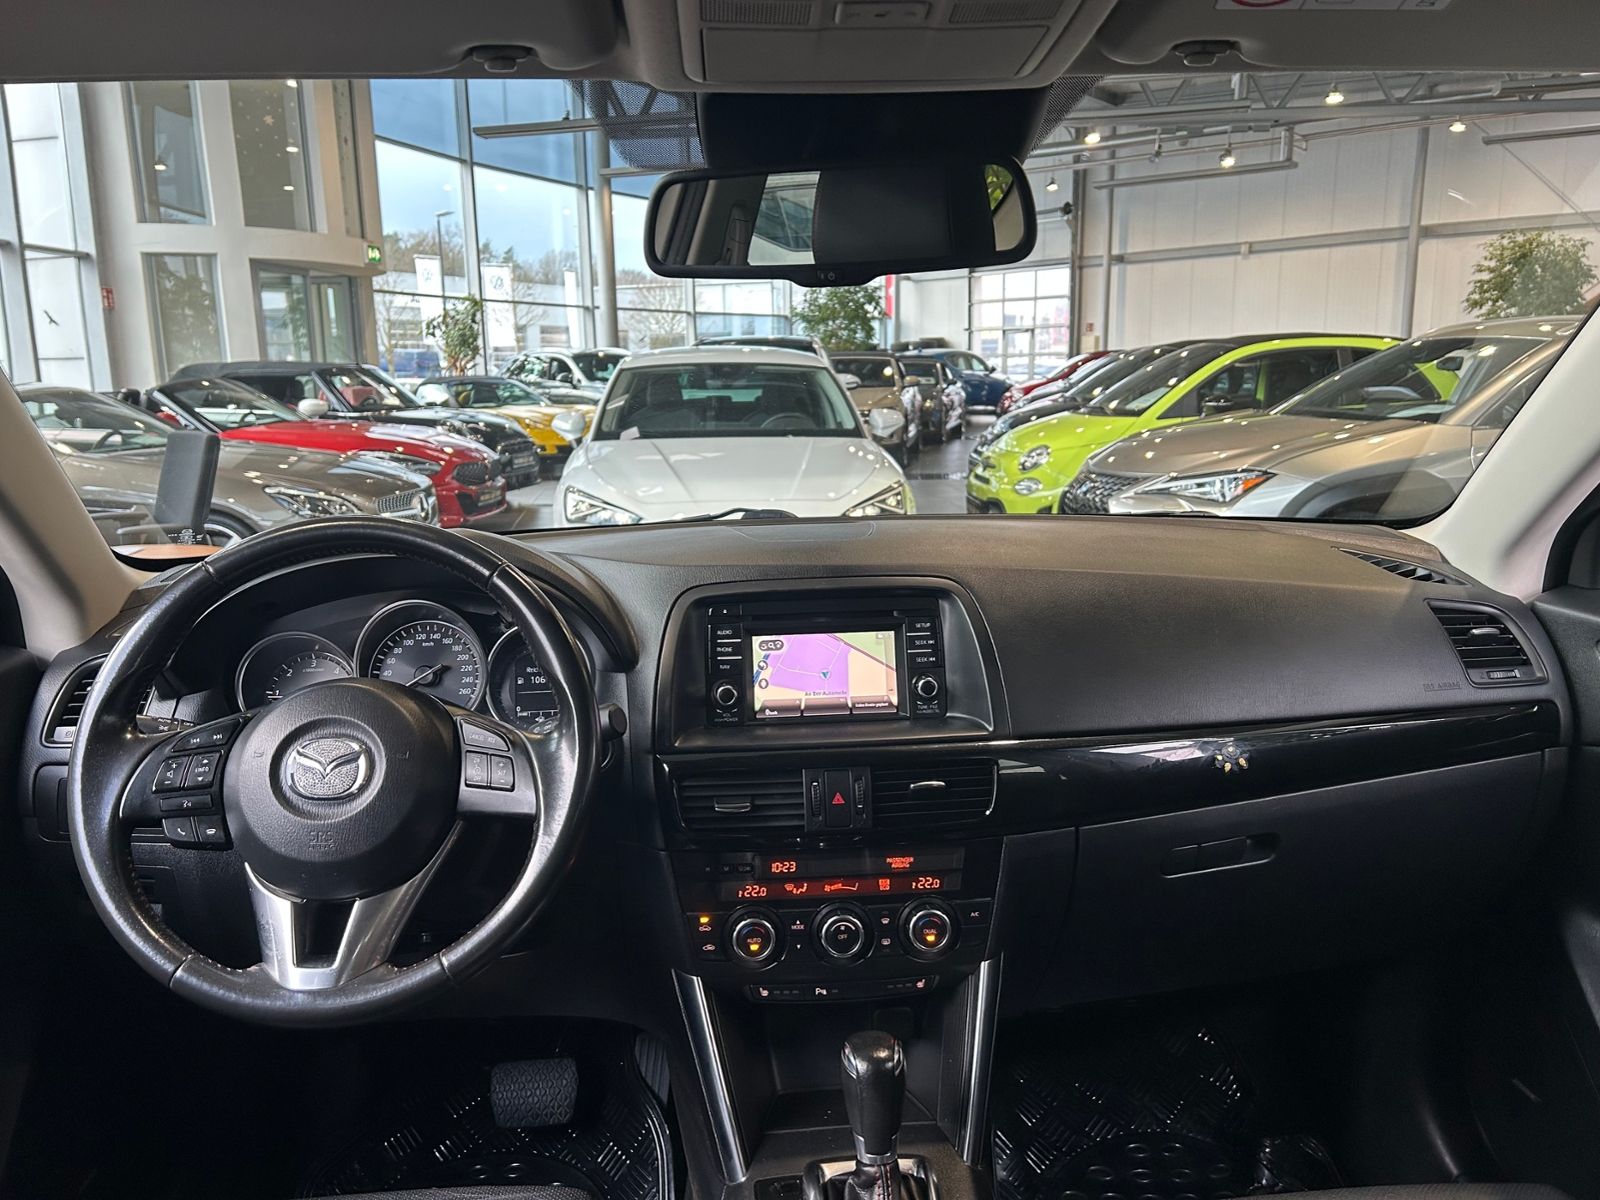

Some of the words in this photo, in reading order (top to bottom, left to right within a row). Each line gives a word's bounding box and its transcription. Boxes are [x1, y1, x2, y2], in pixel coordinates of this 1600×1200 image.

[311, 660, 317, 668] 3
[286, 669, 293, 677] 2
[333, 667, 340, 675] 4
[531, 676, 546, 684] 106
[309, 831, 334, 843] SRS
[771, 861, 796, 873] 10:23
[917, 877, 940, 889] 22.0
[744, 885, 767, 897] 22.0
